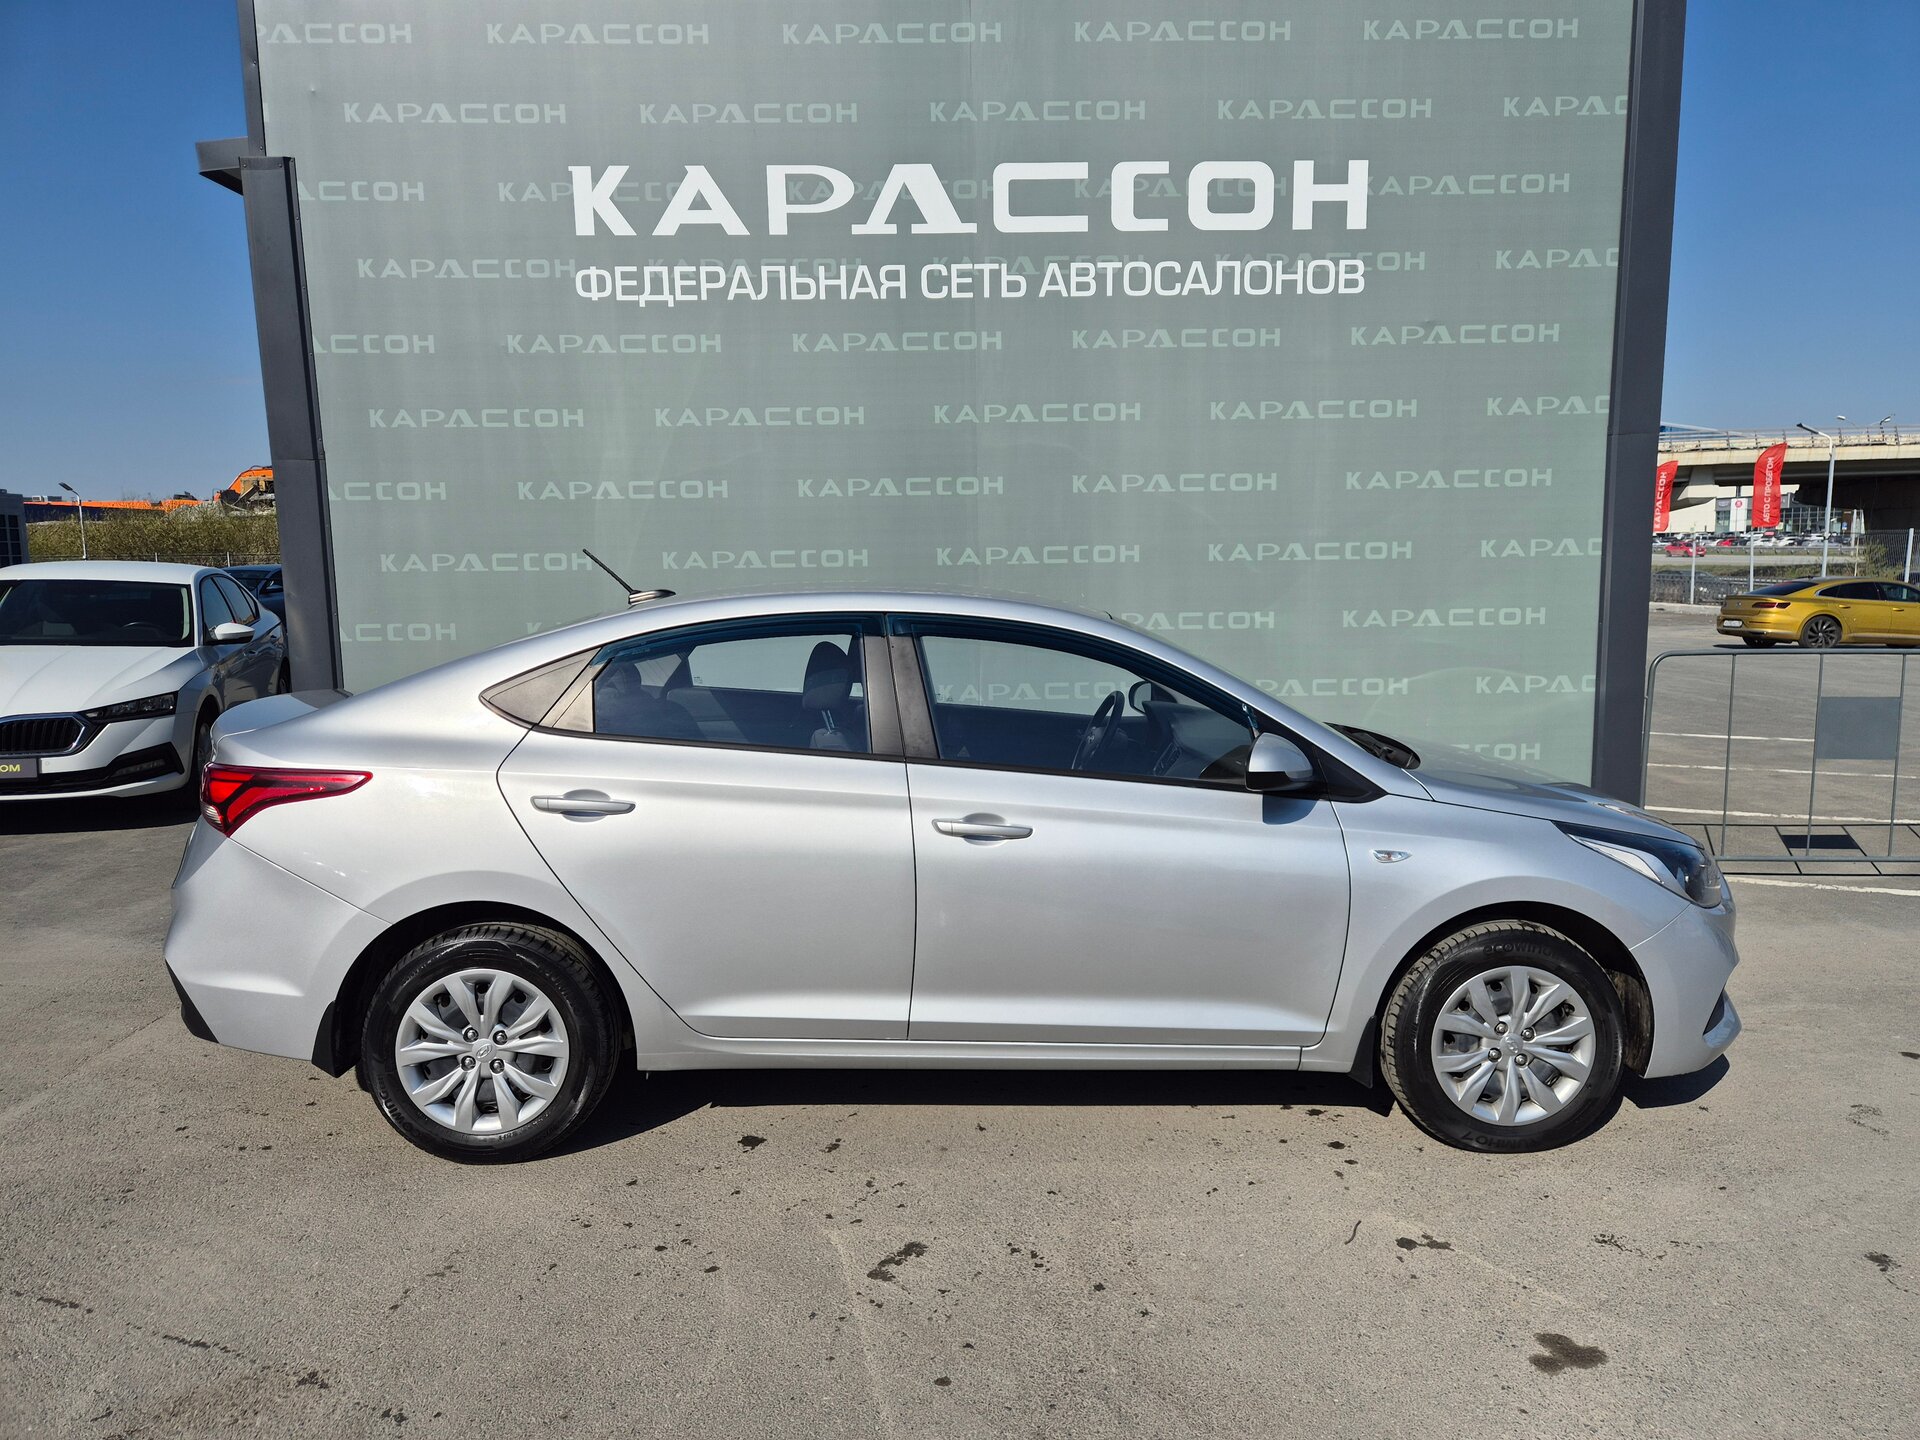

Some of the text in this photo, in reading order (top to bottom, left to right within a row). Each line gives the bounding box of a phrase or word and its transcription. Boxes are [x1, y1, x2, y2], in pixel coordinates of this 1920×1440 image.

[486, 23, 709, 45] КАРАССОН
[782, 20, 1003, 46] КАРАССОН
[1074, 20, 1291, 42] КАРАССОН
[1363, 18, 1579, 40] КАРАССОН
[343, 102, 566, 124] КАРАССОН
[639, 103, 857, 124] КАРАССОН
[930, 100, 1146, 121] КАРАССОН
[1217, 98, 1432, 120] КАРАССОН
[567, 160, 1369, 236] КАРАССОН
[358, 258, 577, 280] КАРАССОН
[575, 258, 1366, 308] ФЕДЕРАЛЬНАЯ СЕТЬ АВТОСАЛОНОВ
[506, 333, 722, 355] КАРАССОН
[792, 330, 1003, 353] КАРАССОН
[1072, 328, 1281, 349] КАРАССОН
[1351, 323, 1560, 345] КАРАССОН
[369, 408, 585, 429] КАРАССОН
[655, 406, 865, 427] КАРАССОН
[934, 402, 1141, 424] КАРАССОН
[1210, 399, 1418, 420] КАРАССОН
[517, 479, 728, 500] КАРАССОН
[797, 475, 1004, 498] КАРАССОН
[1072, 472, 1277, 493] КАРАССОН
[1346, 468, 1552, 490] КАРАССОН
[380, 552, 593, 572] КАРАССОН
[662, 548, 869, 570] КАРАССОН
[936, 544, 1140, 566] КАРАССОН
[1208, 541, 1412, 562] КАРАССОН
[1343, 607, 1546, 630] КАРАССОН
